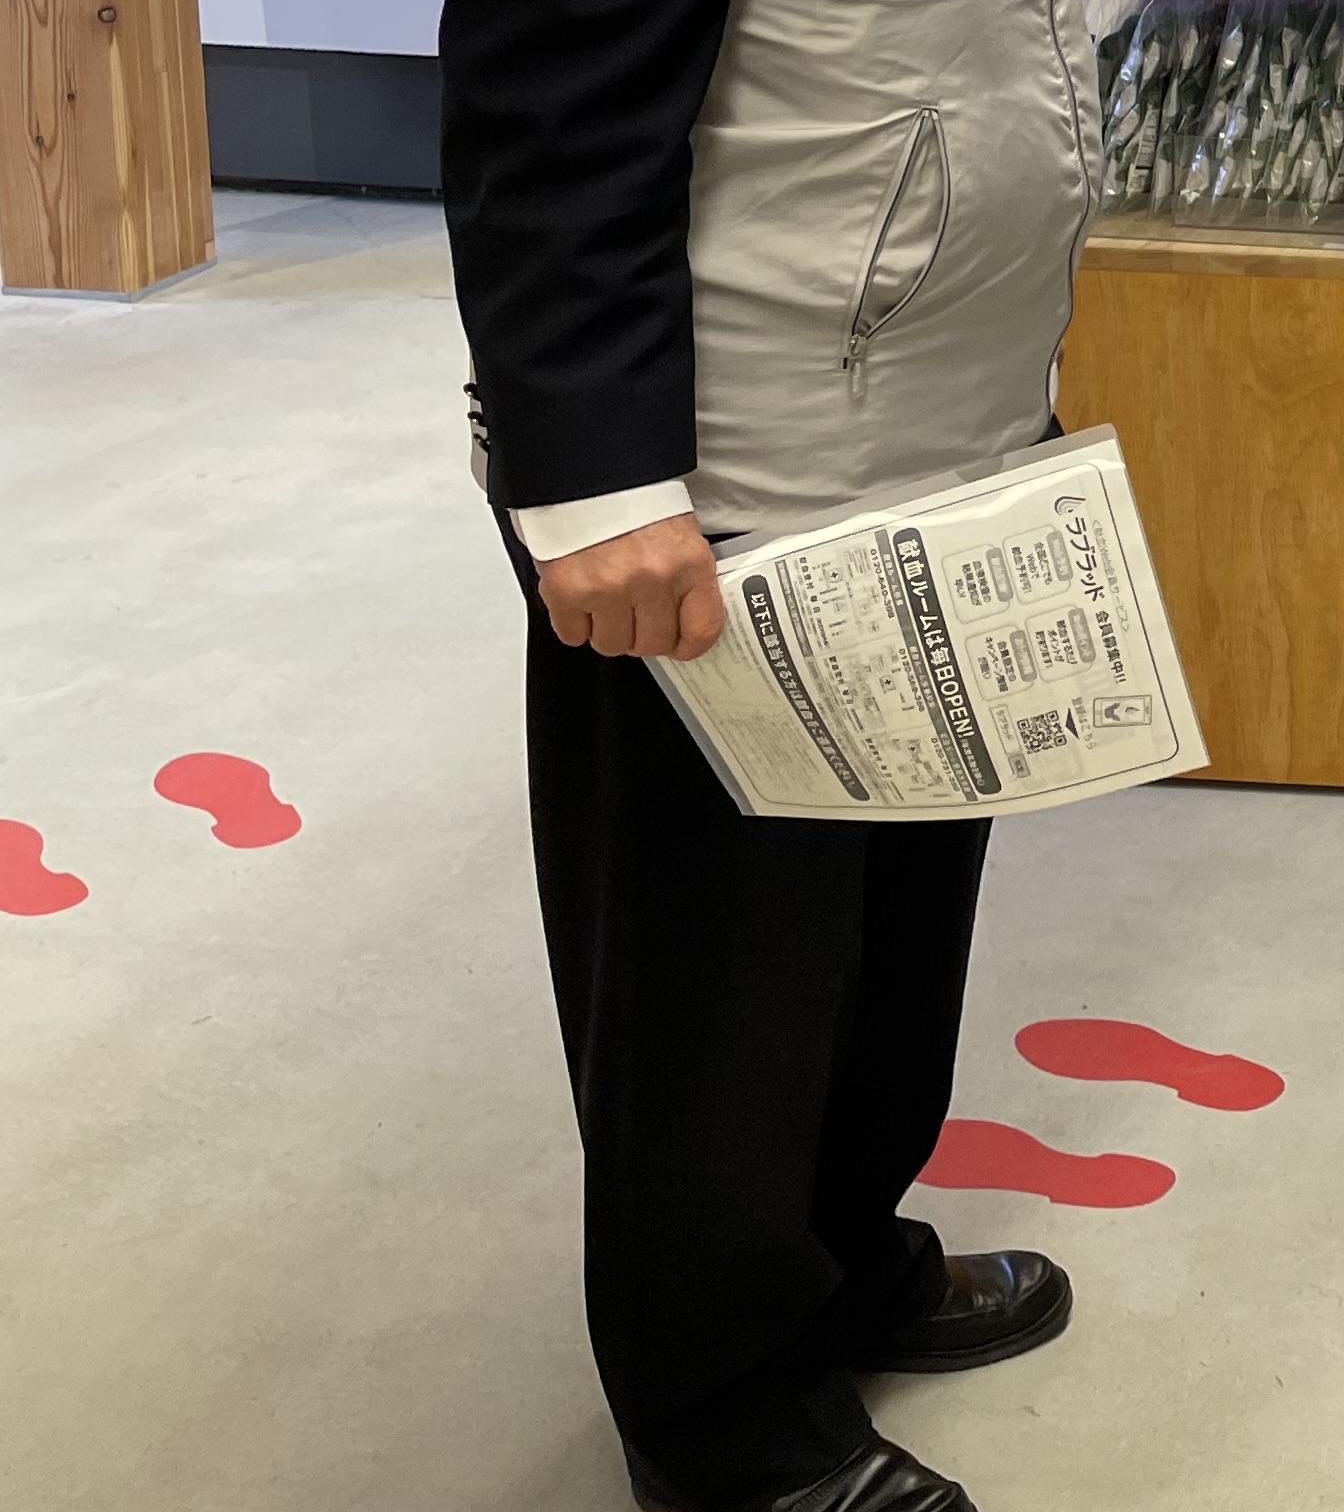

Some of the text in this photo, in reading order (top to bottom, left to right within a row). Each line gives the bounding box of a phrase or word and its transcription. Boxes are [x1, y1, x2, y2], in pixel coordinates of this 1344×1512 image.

[1066, 517, 1105, 602] ラブラッド
